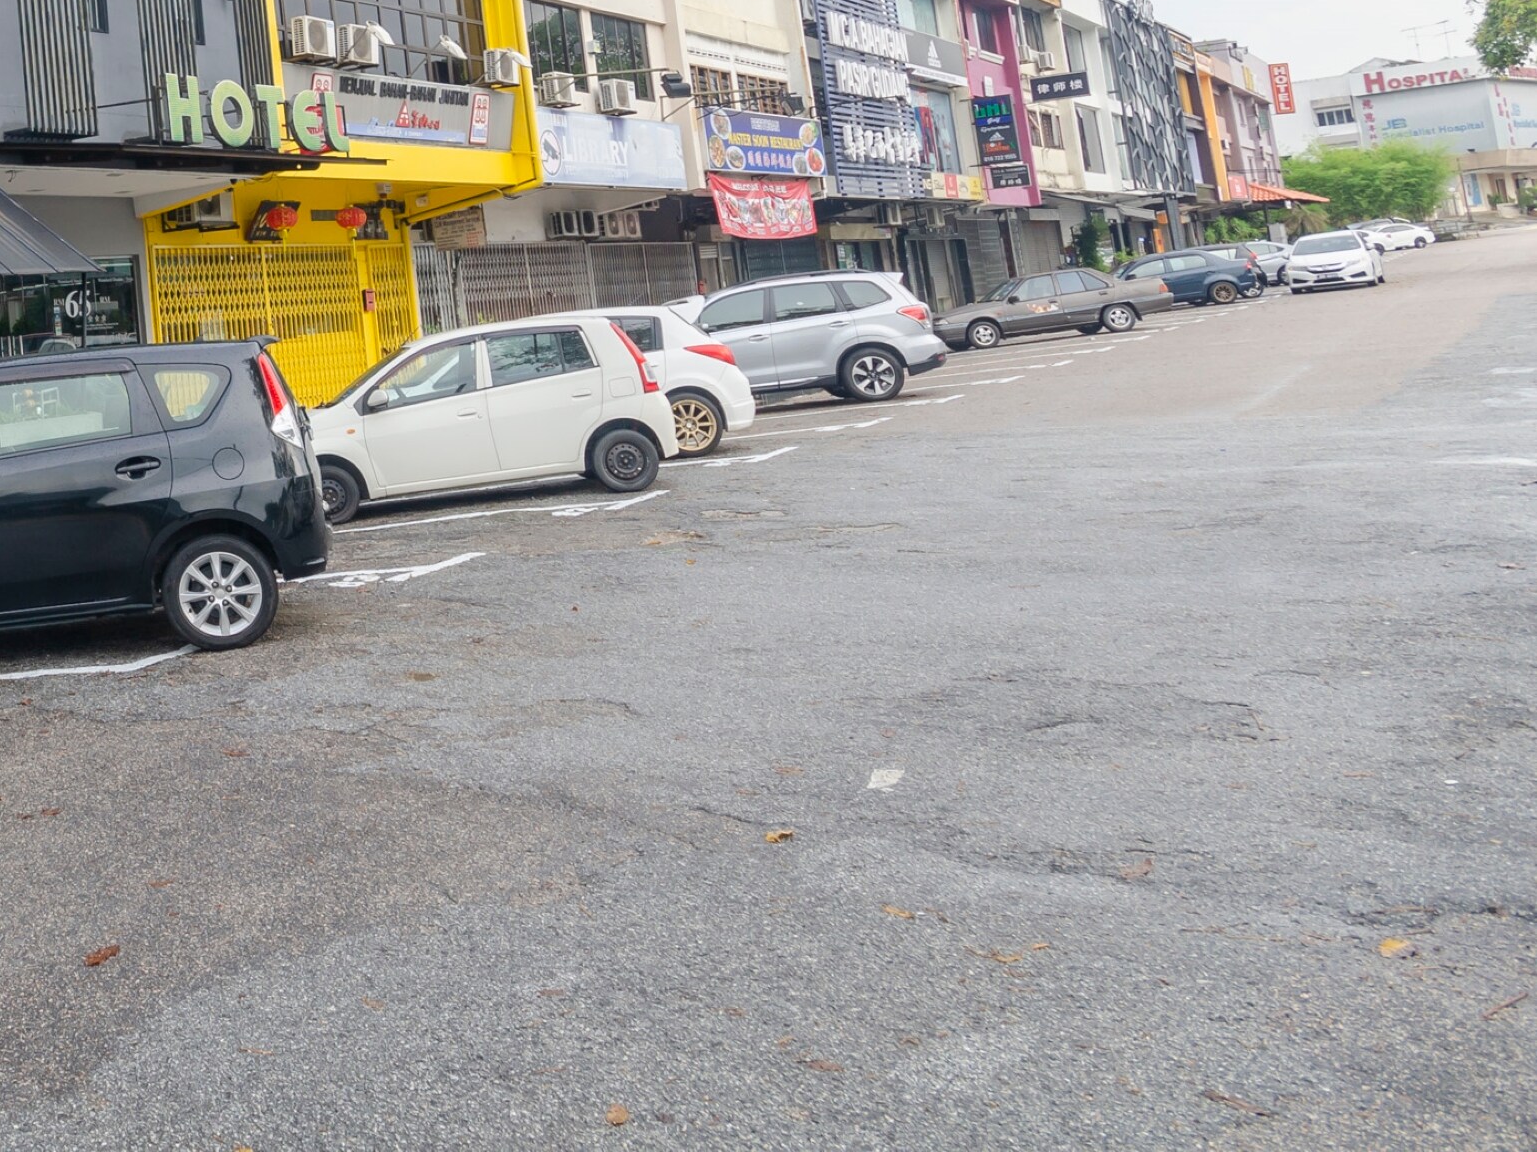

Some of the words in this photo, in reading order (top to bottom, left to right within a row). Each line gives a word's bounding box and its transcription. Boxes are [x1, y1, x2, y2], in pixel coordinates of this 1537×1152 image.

[1273, 65, 1291, 111] HOTEL
[165, 73, 349, 153] HOTEL
[1438, 121, 1485, 135] Hospital
[563, 135, 628, 166] LIBRARY
